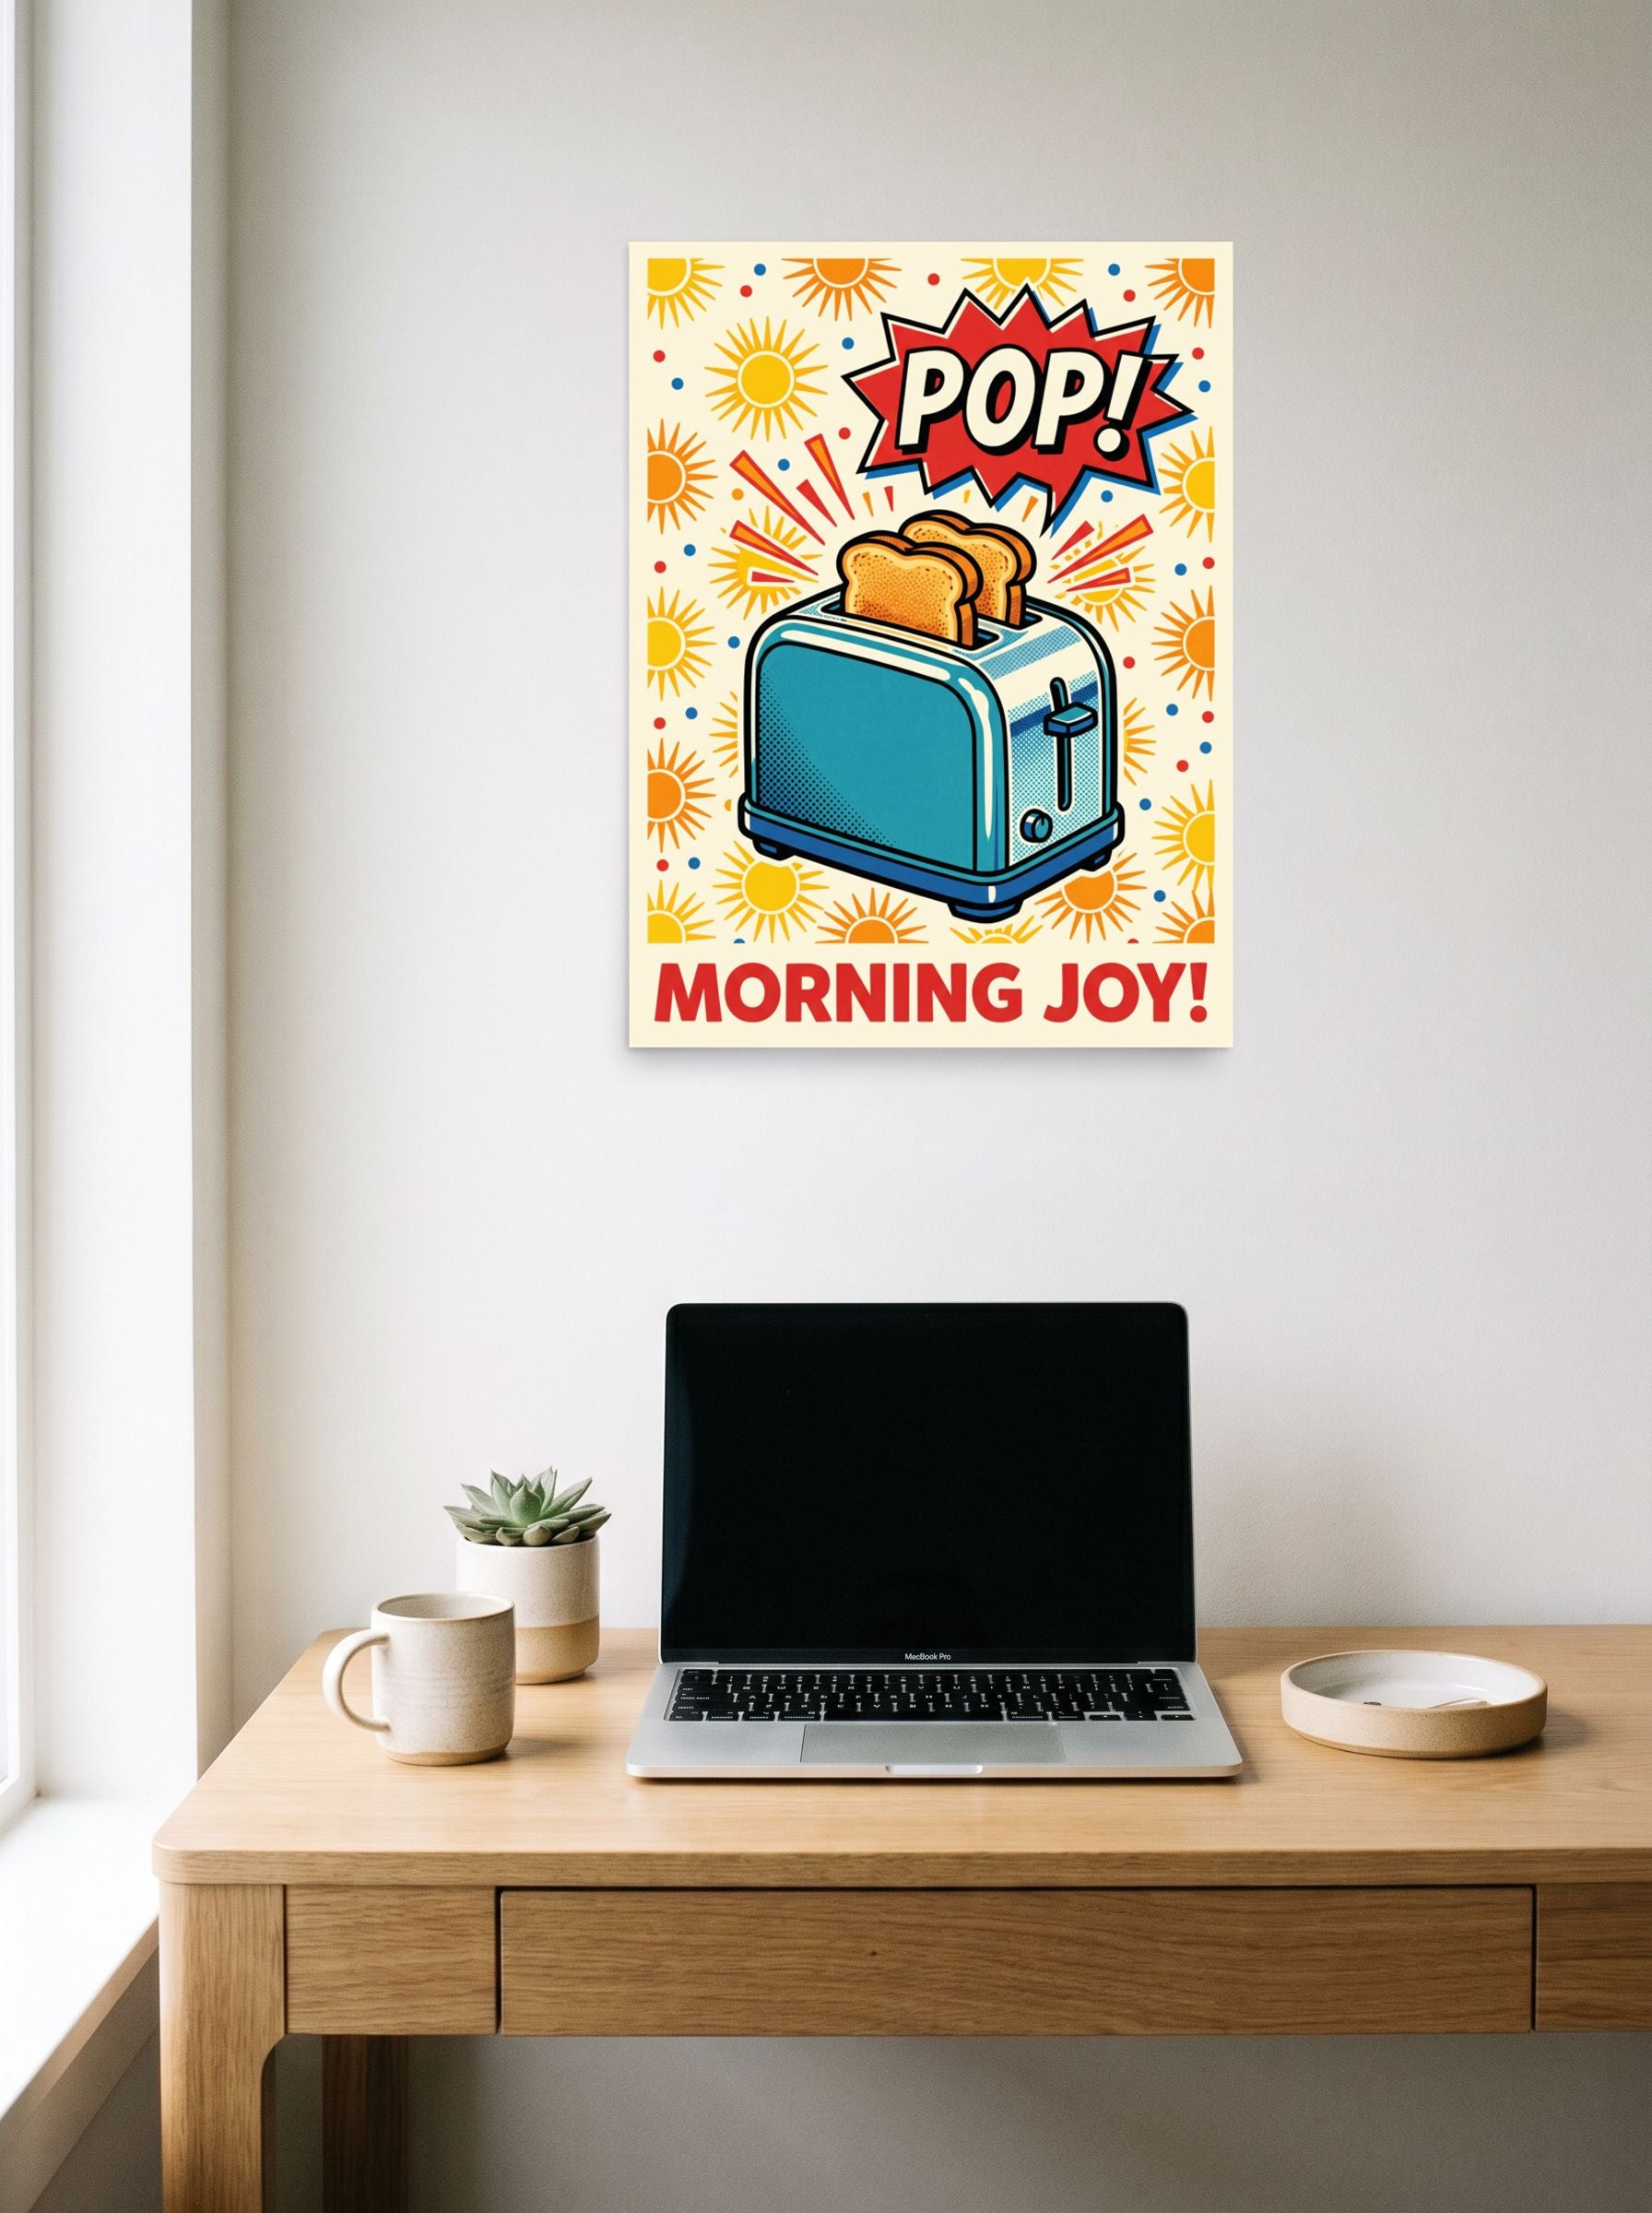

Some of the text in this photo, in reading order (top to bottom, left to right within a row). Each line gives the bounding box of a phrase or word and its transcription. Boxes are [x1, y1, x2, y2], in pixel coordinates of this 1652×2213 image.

[895, 344, 1151, 462] POP!
[655, 962, 1208, 1023] MORNING JOY!
[938, 1652, 952, 1661] Pro
